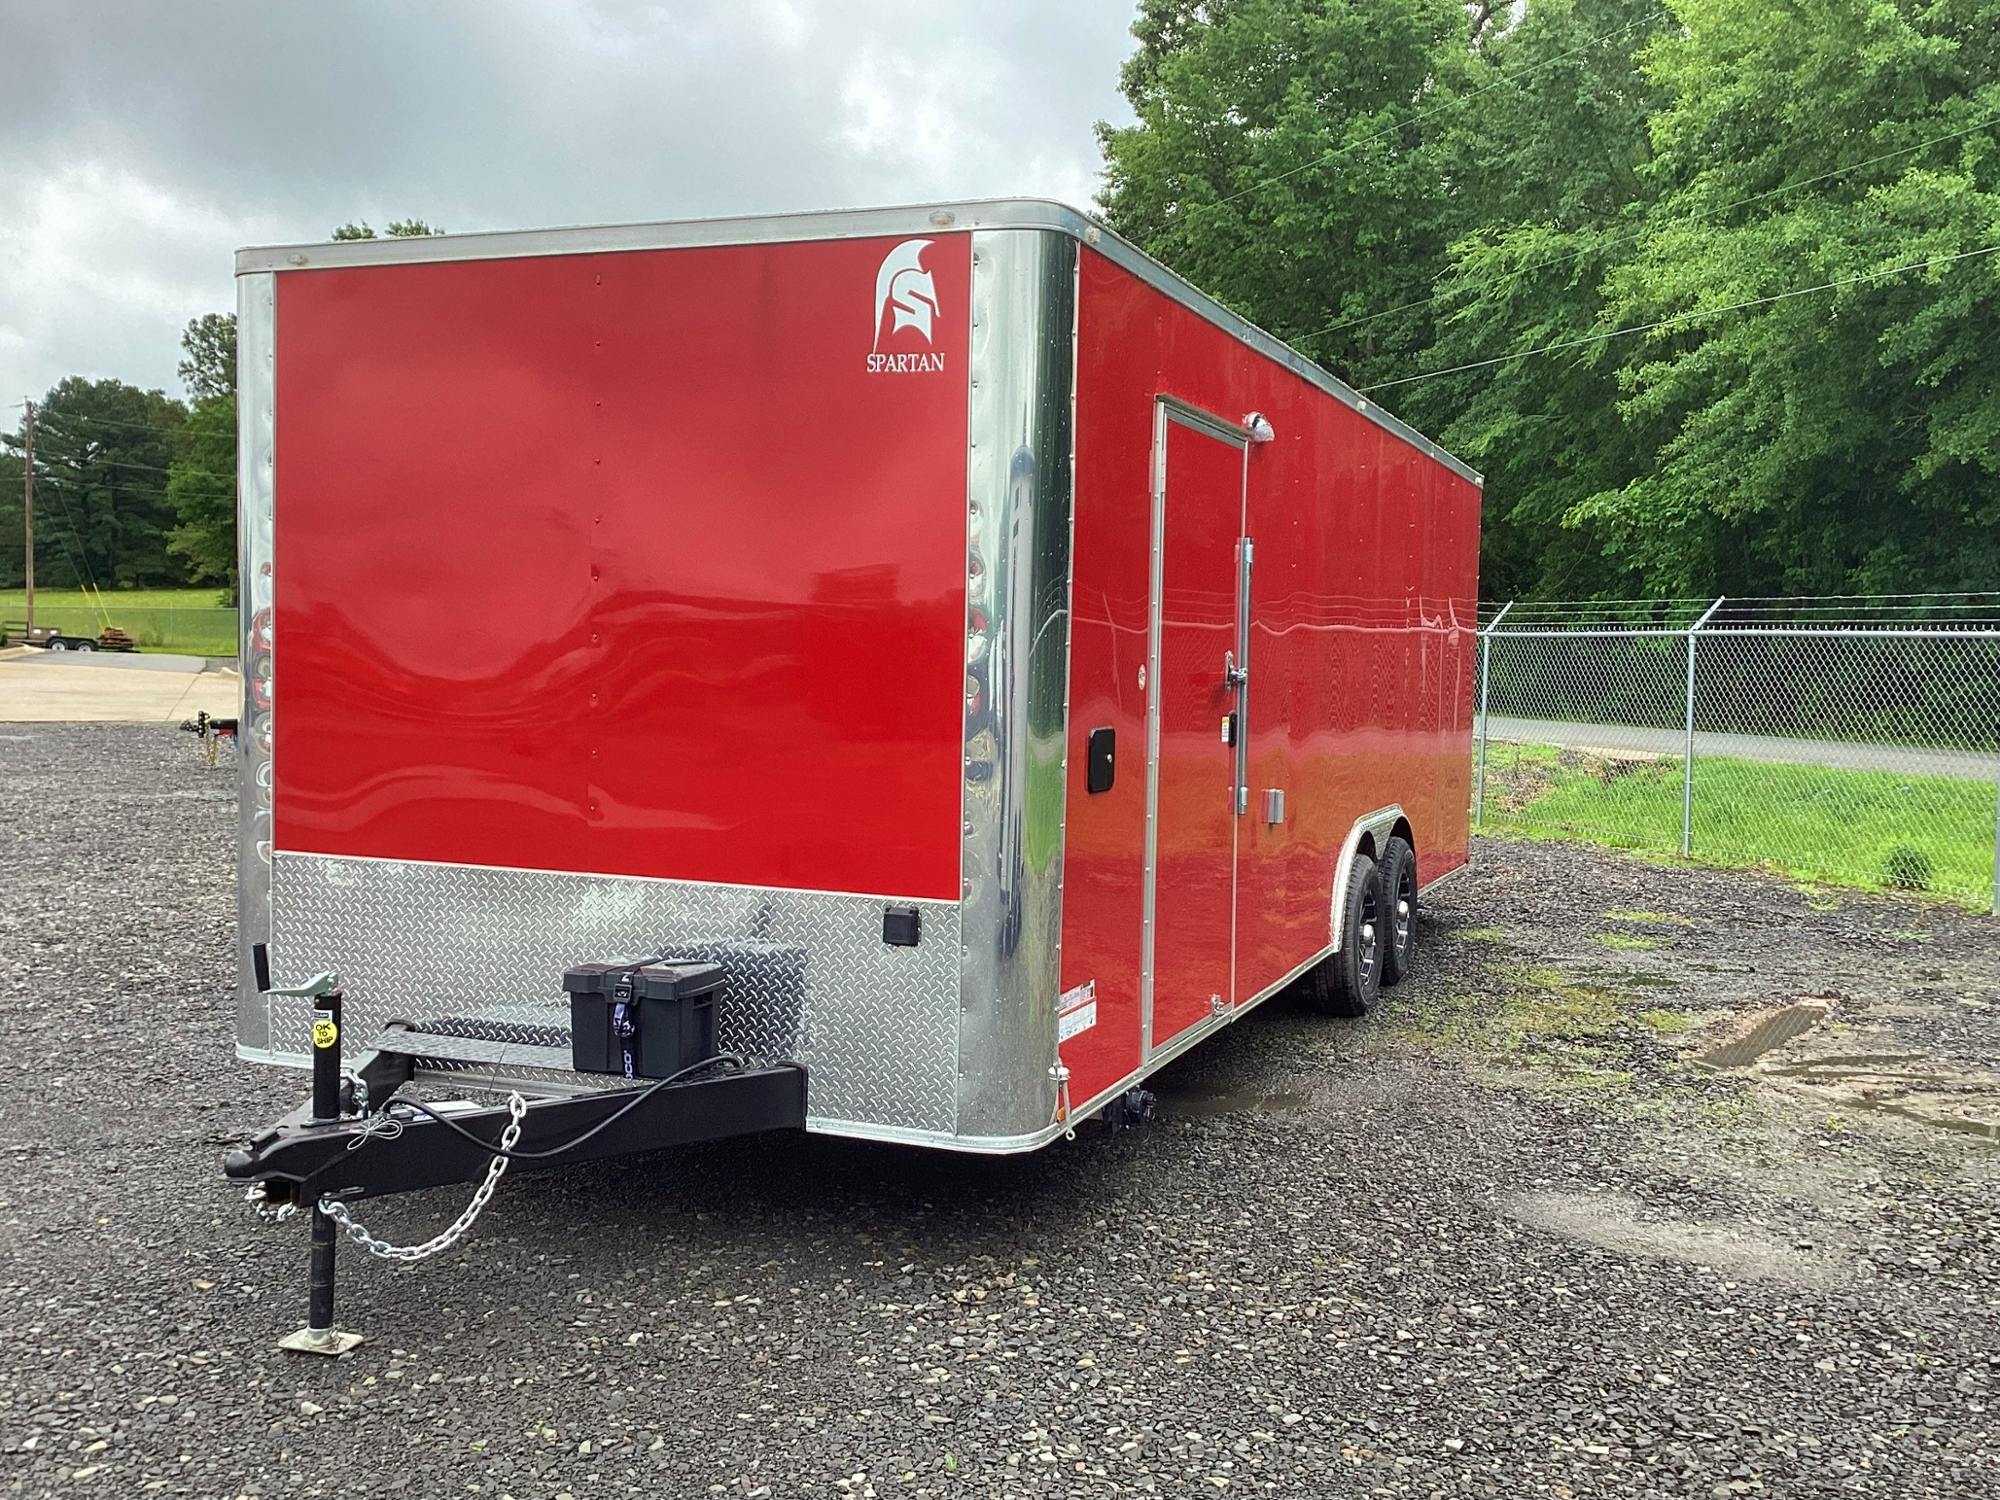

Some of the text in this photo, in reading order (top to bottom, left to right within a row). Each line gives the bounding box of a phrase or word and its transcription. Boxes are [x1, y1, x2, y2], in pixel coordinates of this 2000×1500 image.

[867, 353, 945, 373] SPARTAN
[315, 1023, 332, 1032] OK
[317, 1036, 334, 1045] SHIP
